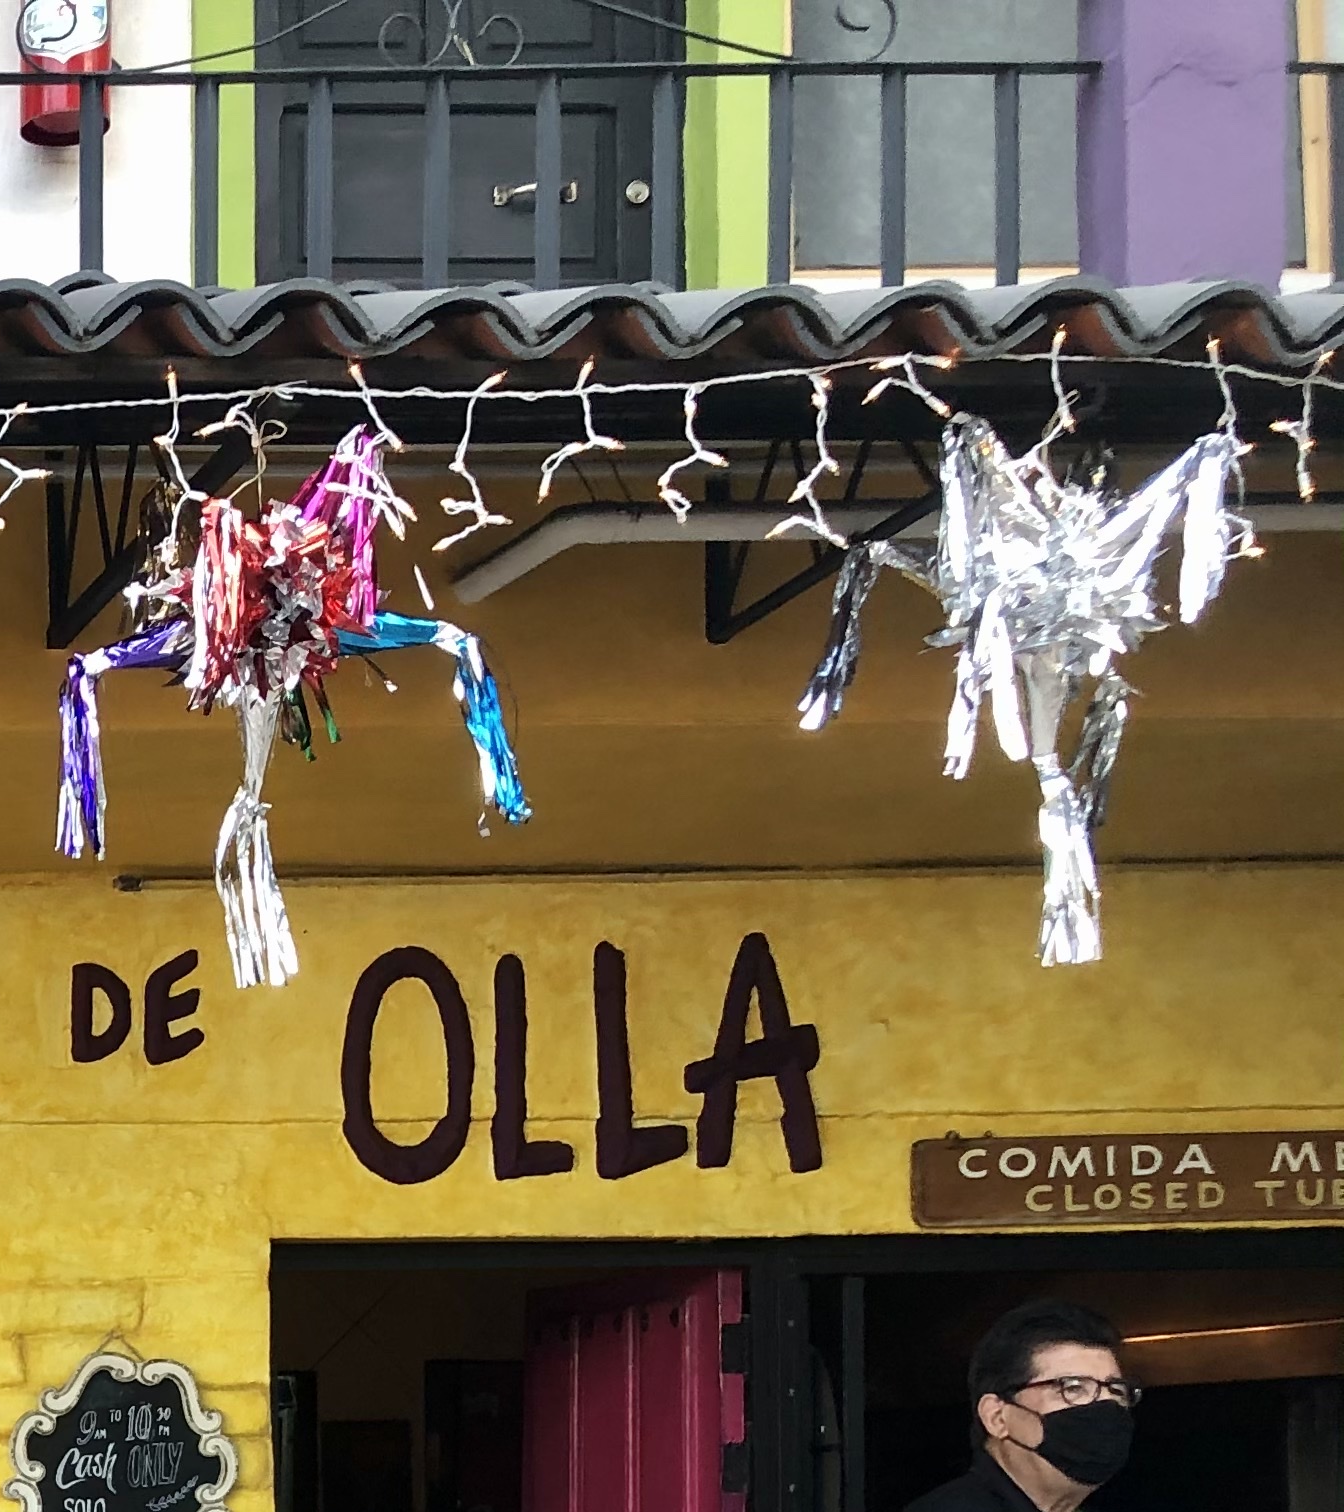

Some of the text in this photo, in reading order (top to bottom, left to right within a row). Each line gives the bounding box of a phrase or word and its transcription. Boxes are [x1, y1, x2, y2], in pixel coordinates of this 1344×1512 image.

[69, 947, 206, 1066] DE
[340, 932, 823, 1181] OLLA
[957, 1143, 1216, 1179] COMIDA
[1024, 1180, 1226, 1212] CLOSED
[109, 1409, 122, 1422] TO
[55, 1441, 184, 1494] Cash ONLY
